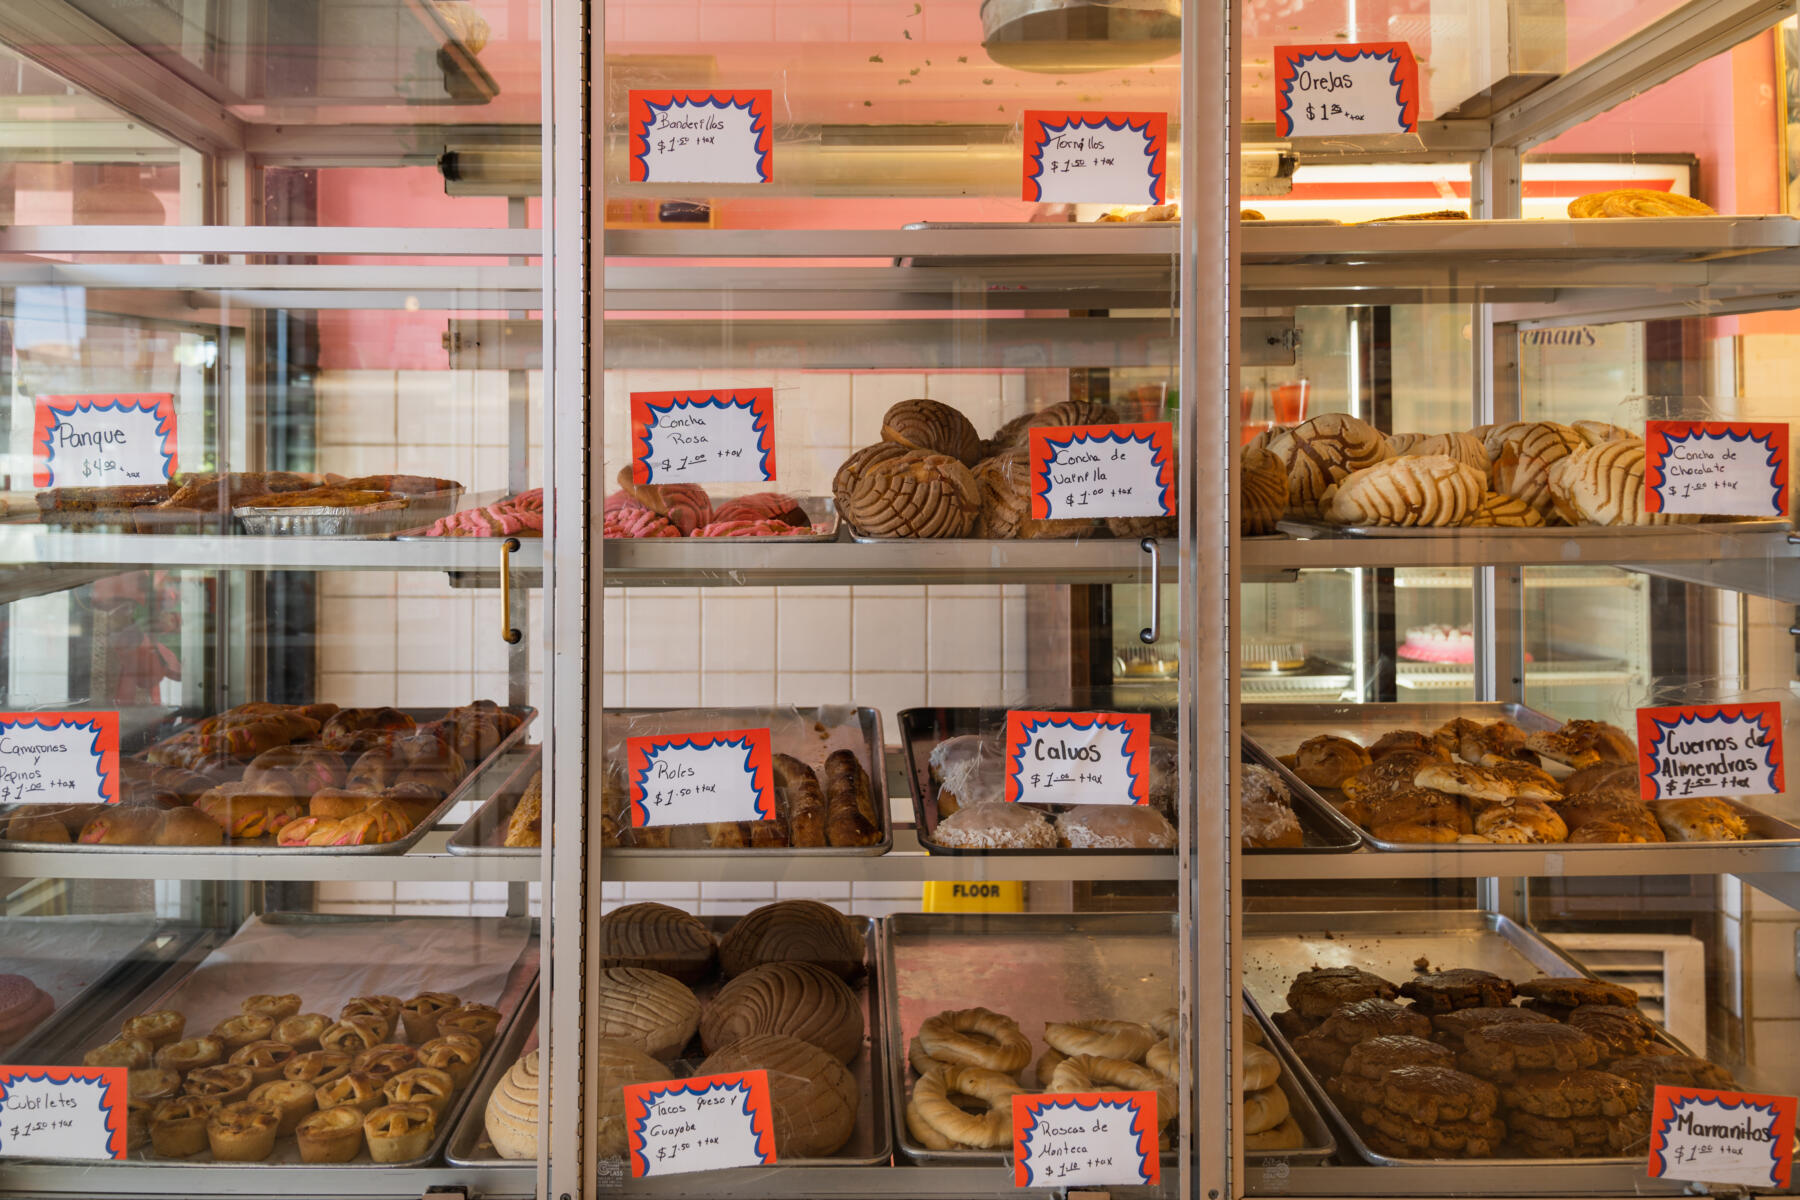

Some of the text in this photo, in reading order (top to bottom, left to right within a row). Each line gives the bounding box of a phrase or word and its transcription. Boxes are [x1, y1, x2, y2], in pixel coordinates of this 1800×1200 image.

[660, 415, 706, 428] Concha
[57, 422, 127, 453] Panque
[667, 432, 708, 444] Rosa
[1056, 448, 1126, 465] Concha de
[1721, 448, 1737, 460] de
[1670, 463, 1725, 476] Chocolate
[653, 760, 695, 779] Roles
[1661, 752, 1758, 778] Almendras
[952, 884, 1000, 897] FLOOR
[650, 1101, 687, 1116] Tacos
[1039, 1118, 1108, 1136] Roscas de
[1677, 1111, 1773, 1142] Marranitos
